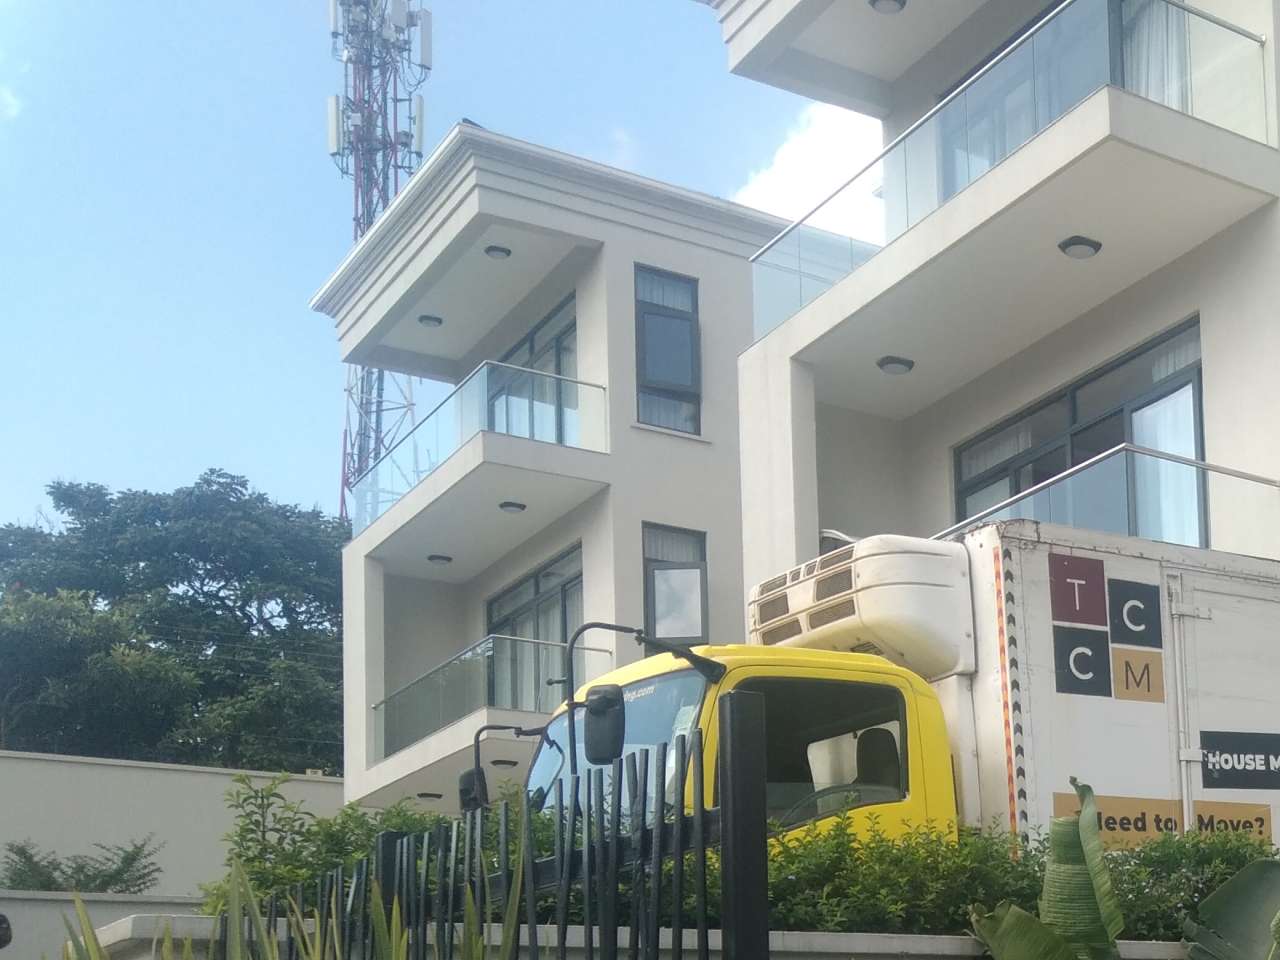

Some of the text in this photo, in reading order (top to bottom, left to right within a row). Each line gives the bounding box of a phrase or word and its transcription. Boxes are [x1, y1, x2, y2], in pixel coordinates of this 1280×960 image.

[1066, 578, 1146, 631] T C
[1069, 646, 1150, 693] C M
[1207, 751, 1266, 770] HOUSE
[1097, 812, 1265, 835] eed to Move?
